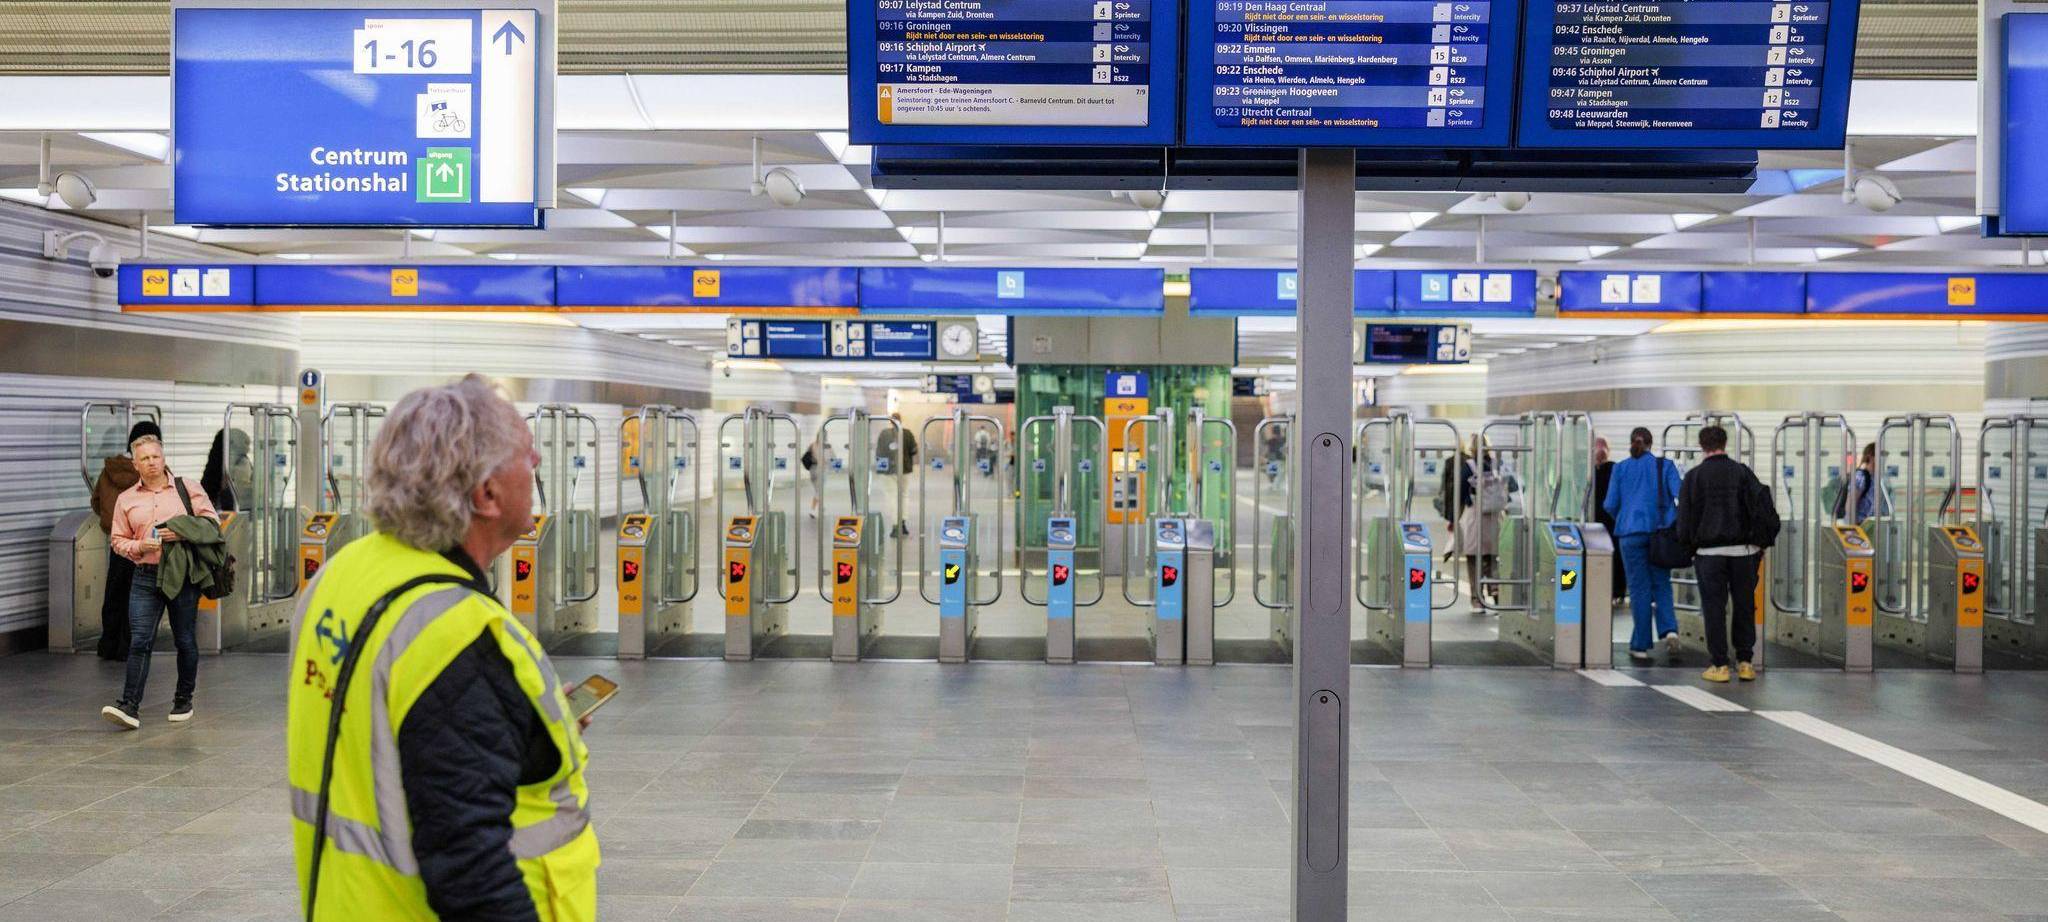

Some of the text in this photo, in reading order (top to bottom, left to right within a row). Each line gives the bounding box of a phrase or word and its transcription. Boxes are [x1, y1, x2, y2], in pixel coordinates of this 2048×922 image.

[879, 0, 981, 11] 09:07 Lelystad Centrum
[1218, 2, 1326, 13] 09:19 Den Haag Centraal
[1557, 3, 1659, 15] 09:37 Lelystad Centrum
[918, 11, 946, 20] Kampen
[947, 11, 964, 19] Zuid,
[1100, 7, 1105, 17] 4
[1115, 11, 1140, 19] Sprinter
[1778, 10, 1783, 19] 3
[1245, 13, 1261, 22] Rijdt
[1278, 12, 1294, 20] door
[1338, 13, 1384, 22] wisselstoring
[1454, 14, 1481, 22] Intercity
[1583, 14, 1593, 22] via
[1595, 15, 1623, 23] Kampen
[1624, 14, 1641, 22] Zuid,
[1793, 14, 1818, 22] Sprinter
[880, 21, 951, 33] 09:16 Groningen
[1218, 23, 1288, 34] 09:20 Vlissingen
[1556, 25, 1622, 34] 09:42 Enschede
[906, 32, 922, 41] Rijdt
[924, 32, 937, 40] niet
[939, 32, 955, 40] door
[999, 33, 1044, 42] wisselstoring
[1244, 34, 1260, 43] Rijdt
[1262, 33, 1276, 41] niet
[1337, 34, 1382, 44] wisselstoring
[1776, 31, 1781, 40] 8
[1593, 36, 1617, 44] Raalte,
[1619, 36, 1650, 45] Nijverdal,
[1652, 36, 1678, 44] Almelo,
[1680, 36, 1709, 45] Hengelo
[880, 43, 976, 54] 09:16 Schiphol Airport
[1217, 45, 1275, 53] 09:22 Emmen
[1554, 46, 1625, 57] 09:45 Groningen
[918, 53, 946, 62] Lelystad
[948, 53, 978, 61] Centrum,
[1100, 50, 1104, 58] 3
[1114, 54, 1140, 62] Intercity
[1436, 52, 1445, 60] 15
[1775, 53, 1779, 61] 7
[1255, 55, 1282, 63] Dalfsen,
[1285, 55, 1313, 63] Ommen,
[1315, 55, 1355, 64] Mariënberg,
[1357, 56, 1397, 65] Hardenberg
[1788, 57, 1815, 65] Intercity
[880, 64, 941, 75] 09:17 Kampen
[1217, 66, 1283, 74] 09:22 Enschede
[1553, 67, 1649, 78] 09:46 Schiphol Airport
[918, 74, 958, 83] Stadshagen
[1097, 71, 1107, 79] 13
[1436, 73, 1441, 81] 9
[1772, 74, 1777, 82] 3
[1255, 76, 1276, 84] Heino,
[1278, 76, 1307, 84] Wierden,
[1309, 76, 1335, 84] Almelo,
[1337, 77, 1365, 86] Hengelo
[1590, 78, 1618, 87] Lelystad
[1620, 78, 1650, 86] Centrum,
[1786, 78, 1813, 86] Intercity
[1216, 87, 1338, 98] 09:23 Groningen Hoogeveen
[1551, 89, 1612, 99] 09:47 Kampen
[1254, 97, 1279, 106] Meppel
[1433, 94, 1442, 102] 14
[1768, 95, 1777, 103] 12
[1589, 99, 1628, 108] Stadshagen
[1216, 108, 1311, 116] 09:23 Utrecht Centraal
[1550, 109, 1628, 118] 09:48 Leeuwarden
[1241, 118, 1257, 127] Rijdt
[1333, 118, 1378, 127] wisselstoring
[1587, 120, 1613, 128] Meppel,
[1616, 120, 1651, 128] Steenwijk,
[1768, 116, 1773, 124] 6
[1782, 119, 1808, 127] Intercity
[310, 146, 408, 166] Centrum
[276, 172, 408, 192] Stationshal
